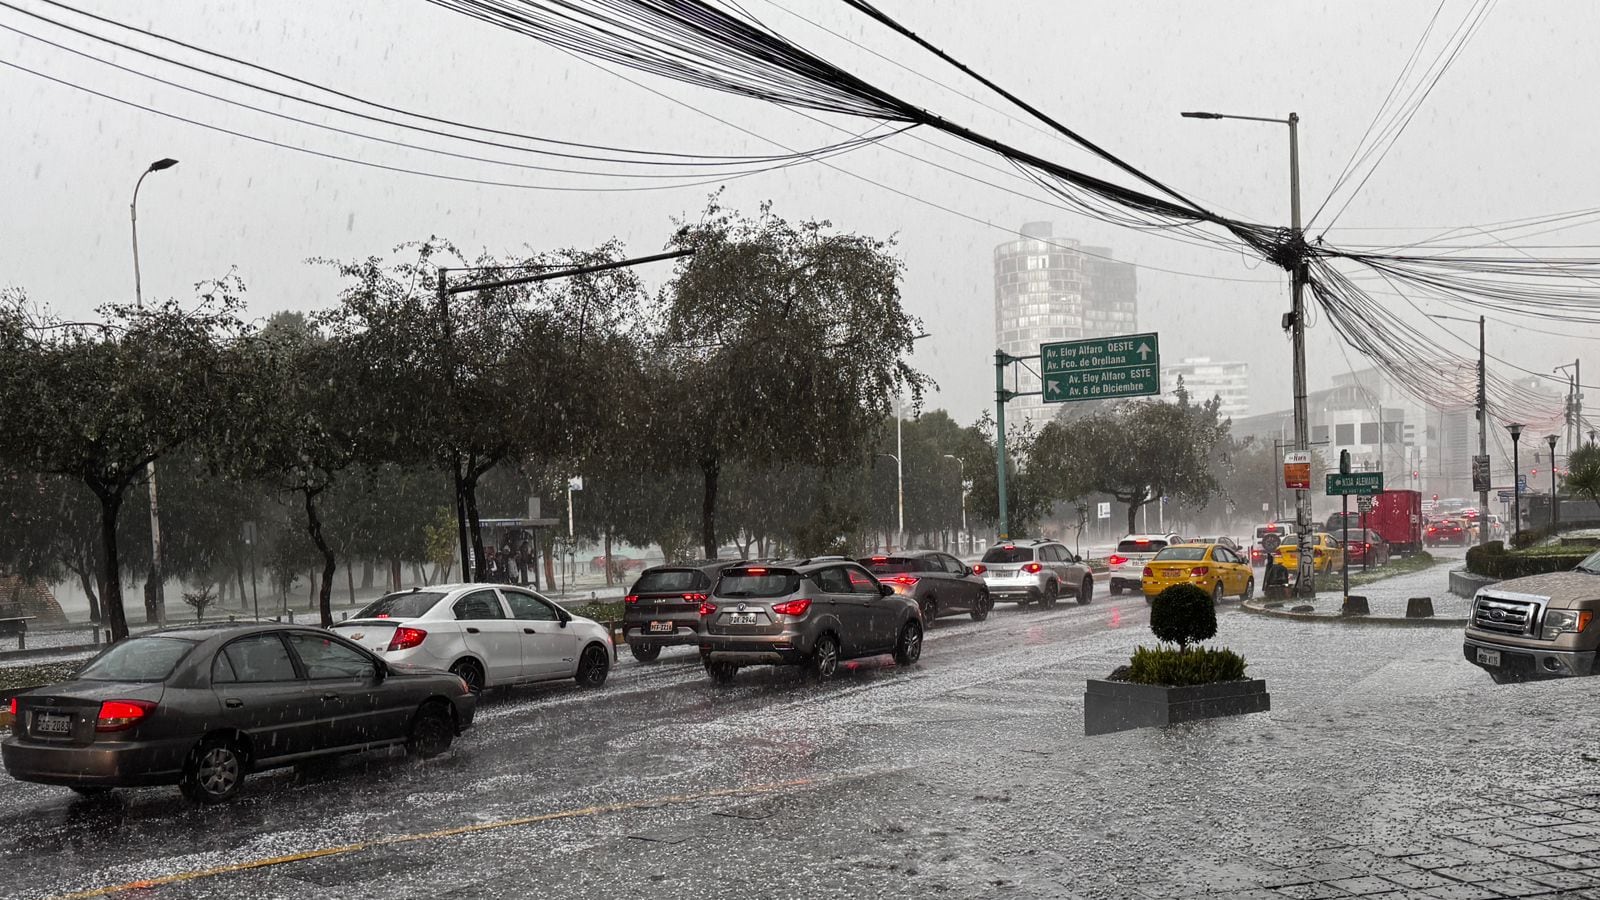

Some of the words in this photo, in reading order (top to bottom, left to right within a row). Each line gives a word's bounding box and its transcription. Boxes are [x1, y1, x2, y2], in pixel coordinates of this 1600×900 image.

[1046, 348, 1058, 358] Av.
[1060, 348, 1076, 358] Eloy
[1078, 346, 1103, 355] Alfaro
[1108, 342, 1134, 351] OESTE
[1047, 361, 1058, 370] Av.
[1061, 359, 1077, 368] Fco.
[1080, 358, 1090, 366] de
[1092, 355, 1126, 365] Orellana
[1069, 375, 1080, 383] Av.
[1082, 373, 1099, 384] Eloy
[1101, 371, 1126, 381] Alfaro
[1130, 369, 1151, 378] ESTE
[1069, 387, 1081, 396] Av.
[1083, 386, 1088, 395] 6
[1090, 385, 1100, 394] de
[1102, 382, 1144, 393] Diciembre
